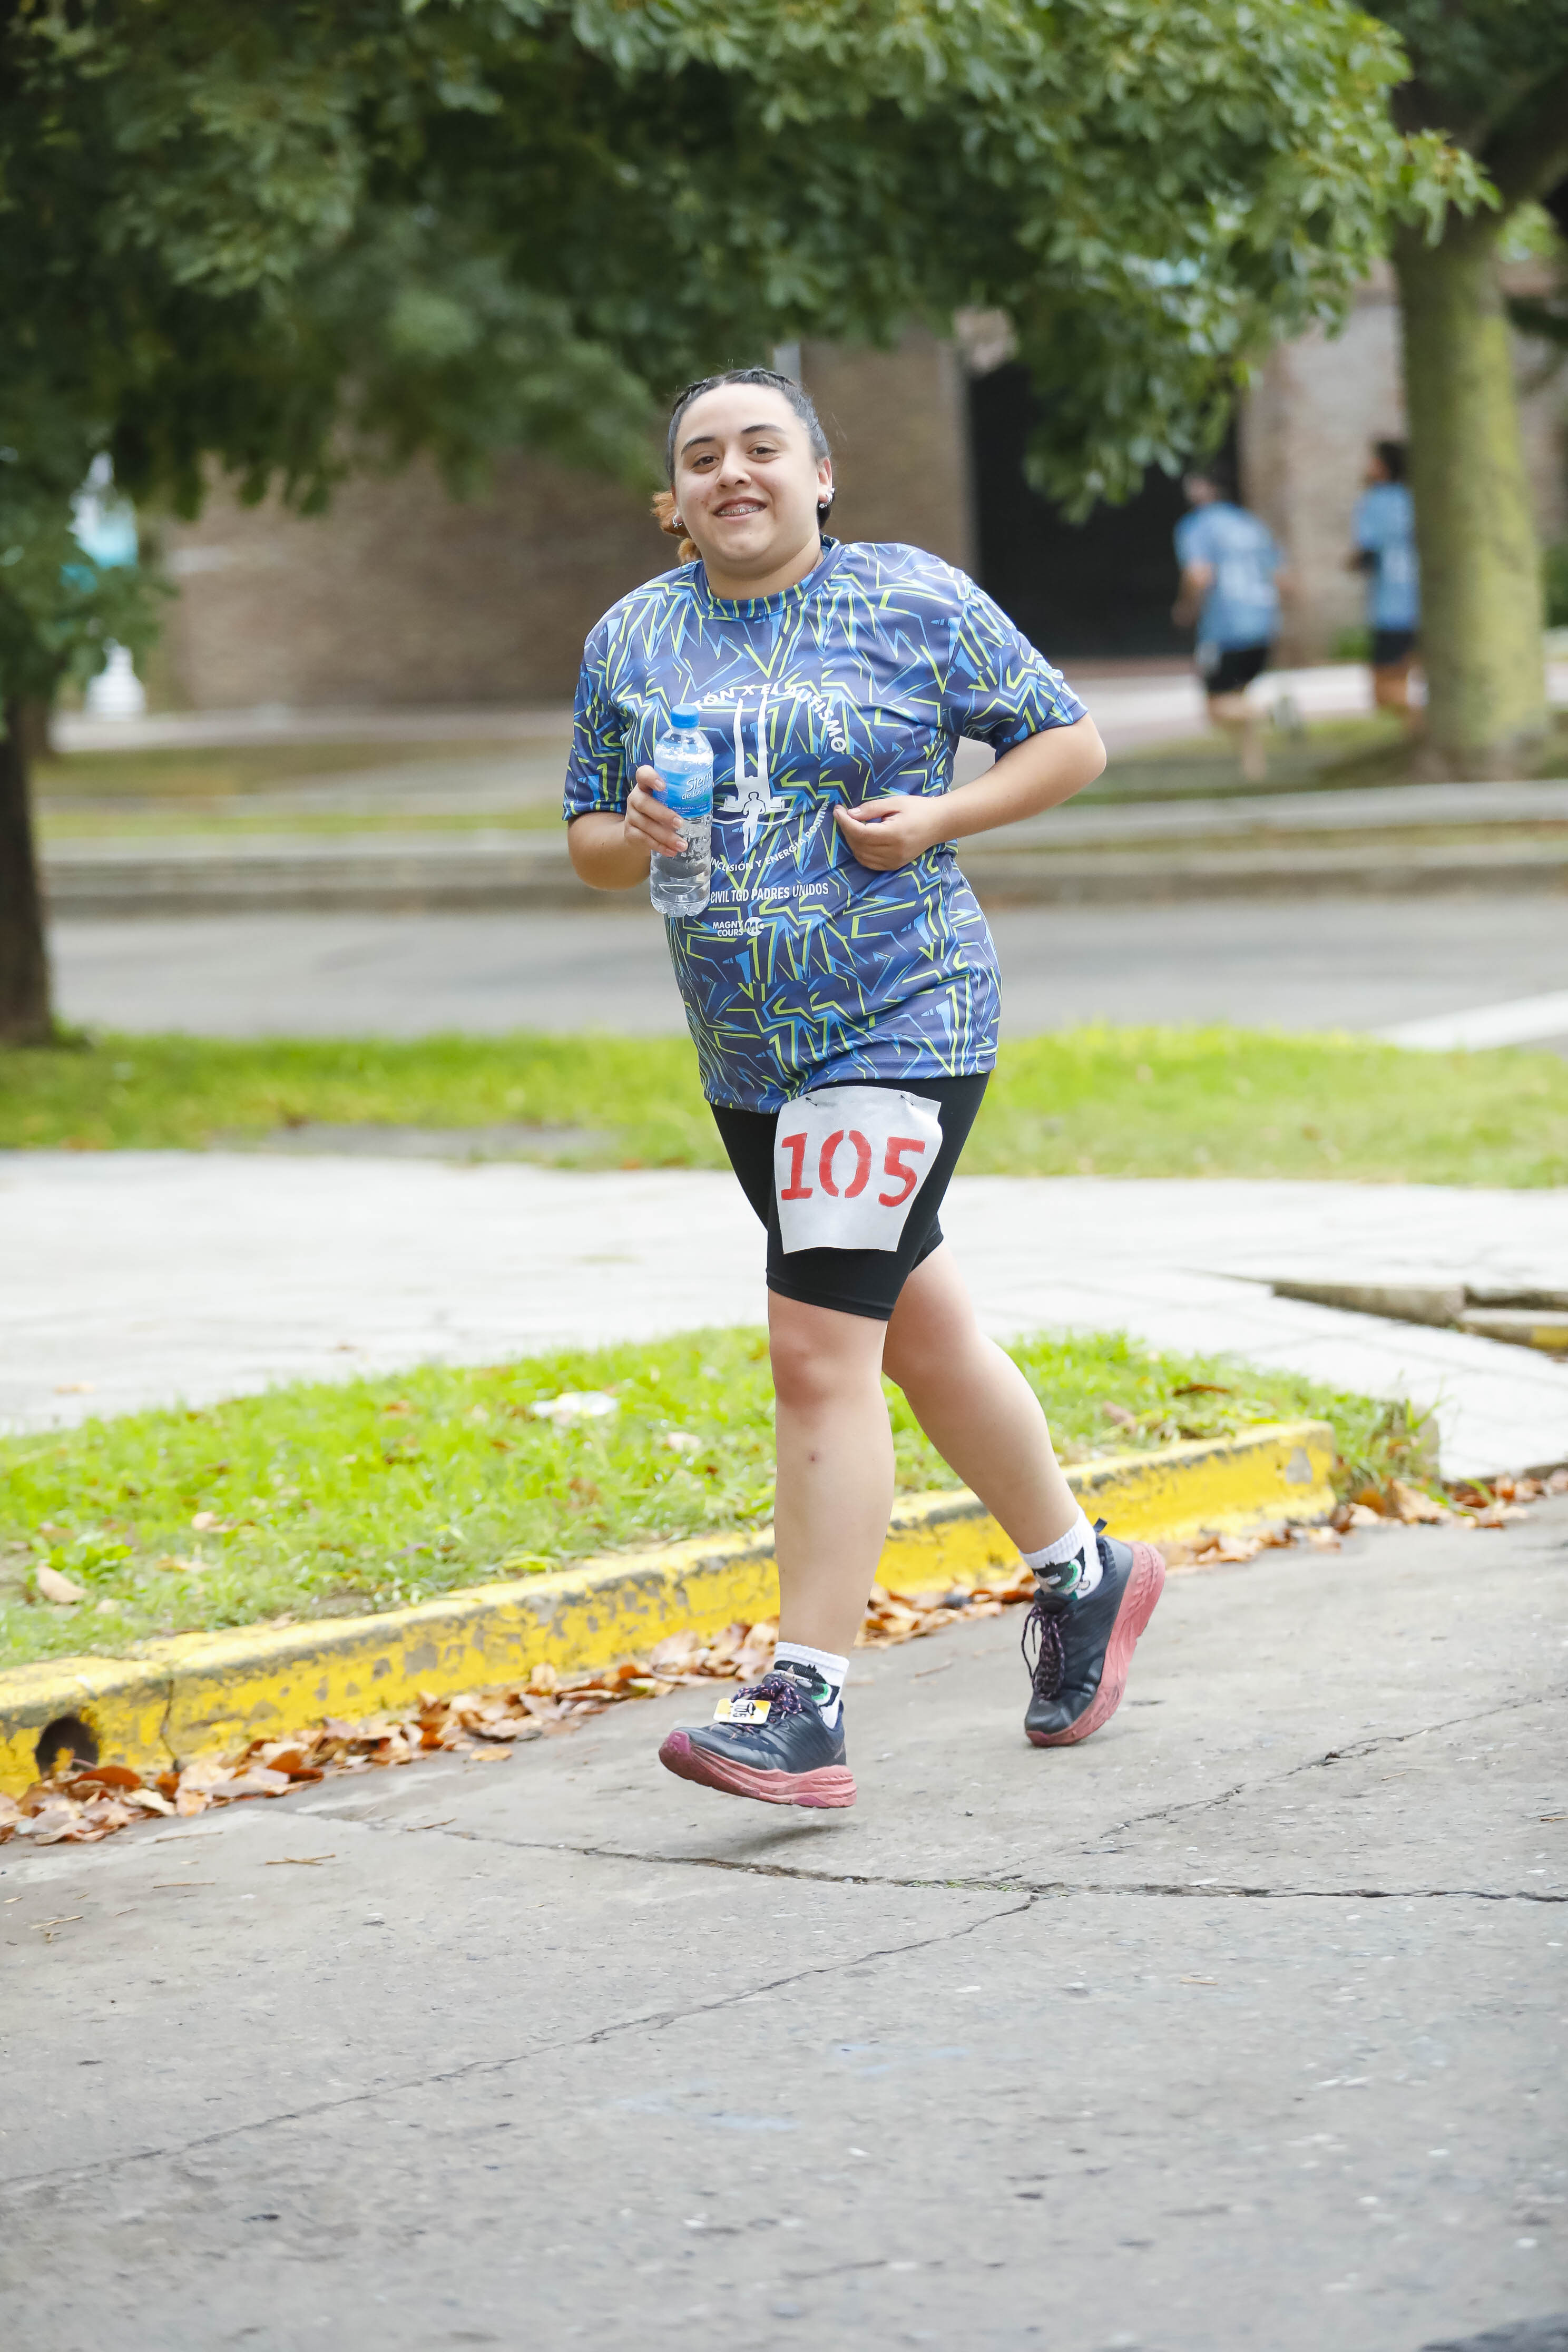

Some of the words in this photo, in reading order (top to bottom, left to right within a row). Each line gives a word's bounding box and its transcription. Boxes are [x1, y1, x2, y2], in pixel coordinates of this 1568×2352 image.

[741, 684, 756, 696] X
[761, 683, 779, 695] EL
[780, 685, 847, 752] AUTISMO
[710, 857, 754, 872] INCLUSIÓN
[755, 859, 762, 868] Y
[766, 838, 807, 865] ENERGÍA
[805, 800, 830, 838] POSITIVA
[710, 890, 730, 904] CIVIL
[731, 889, 750, 903] TGD
[750, 886, 790, 901] PADRES
[792, 883, 829, 897] UNIDOS
[712, 919, 744, 929] MAGNY
[717, 927, 744, 937] COURS
[780, 1129, 926, 1208] 105
